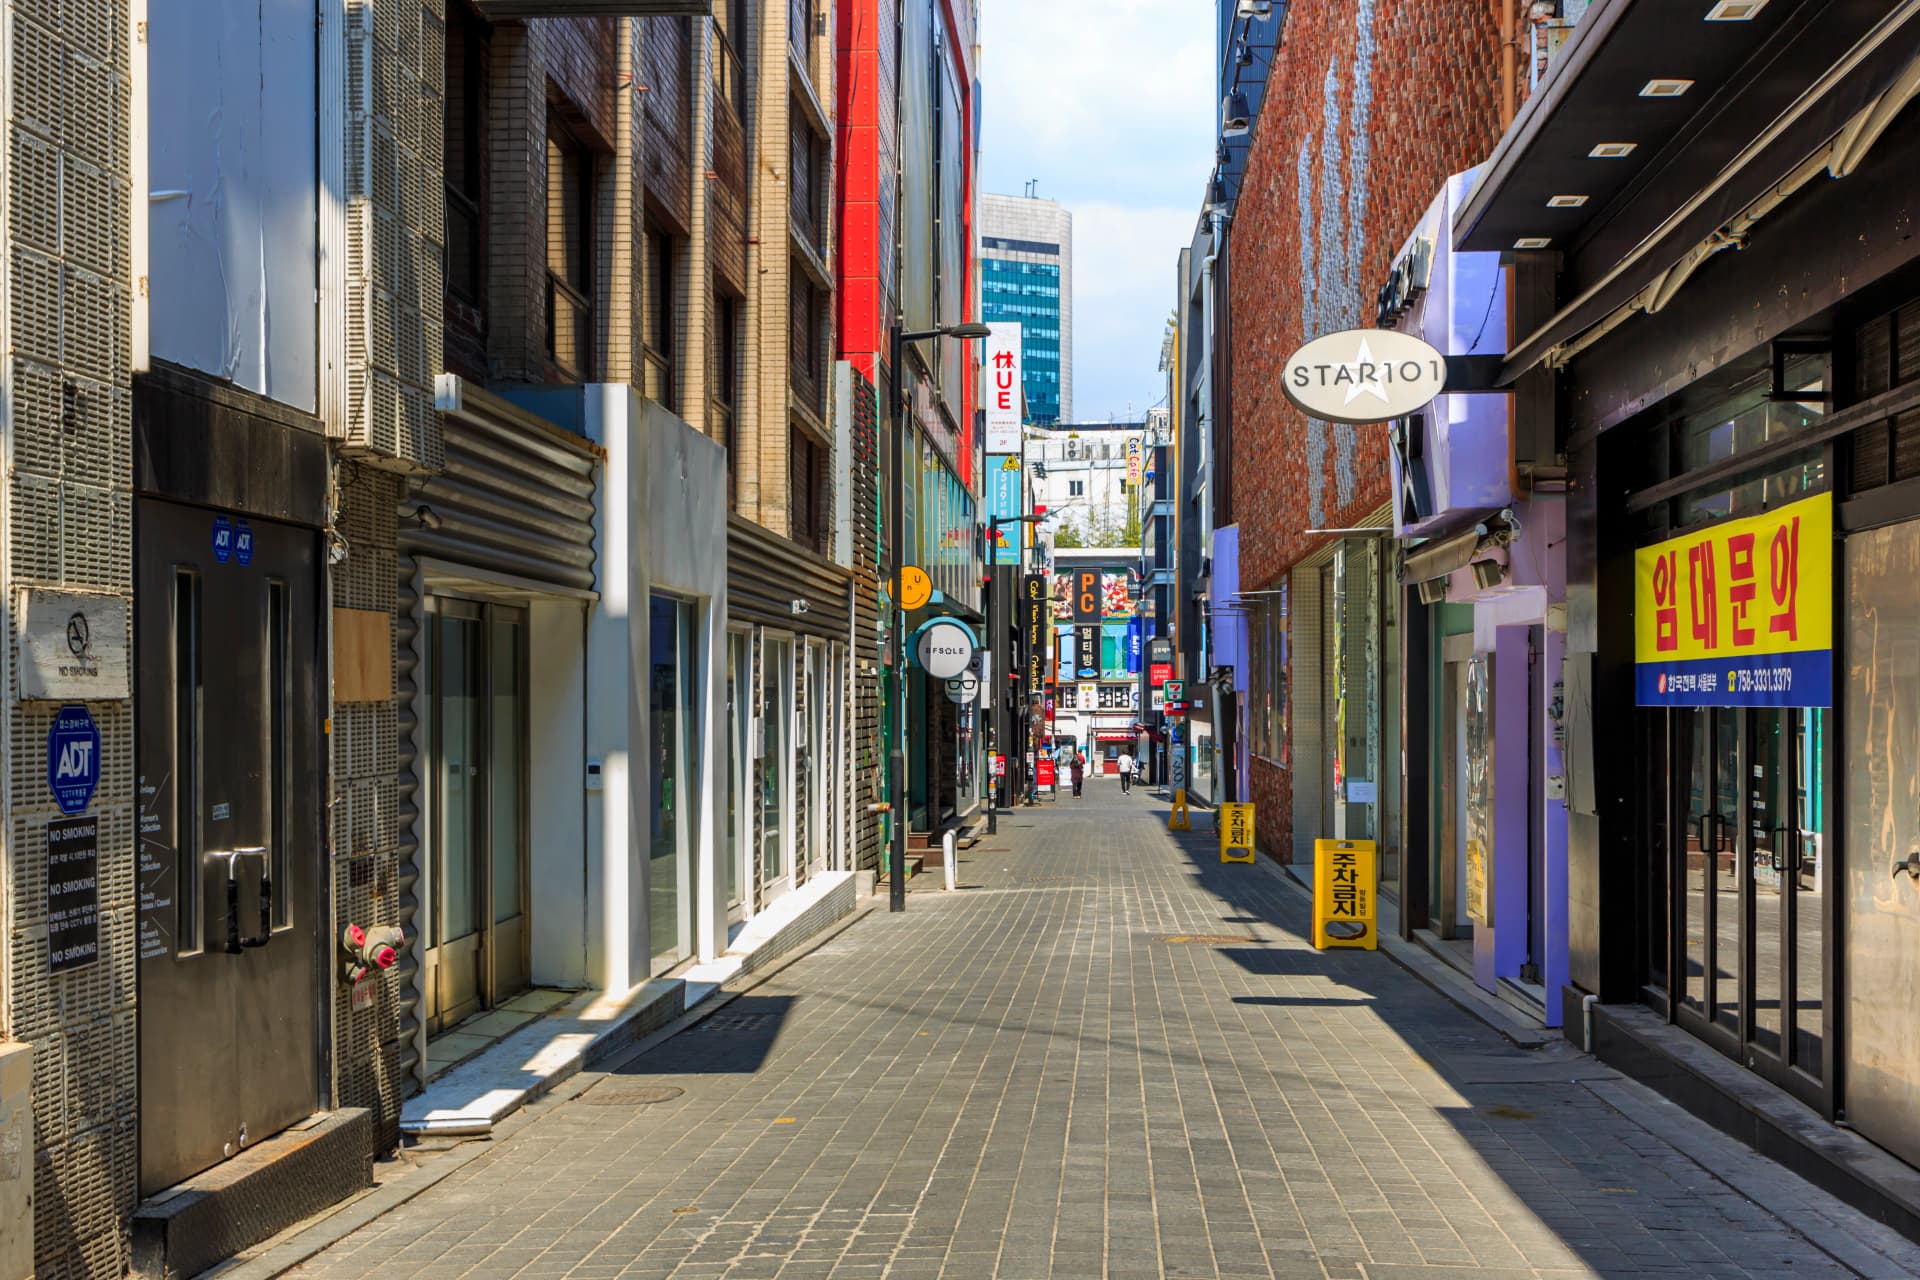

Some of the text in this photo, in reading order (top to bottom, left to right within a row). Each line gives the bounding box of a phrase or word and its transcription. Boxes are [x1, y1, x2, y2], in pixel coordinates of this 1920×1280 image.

[1293, 360, 1439, 388] STAR101
[1129, 438, 1139, 478] Cat Cafe
[216, 530, 230, 547] ADT
[237, 533, 251, 551] ADT
[1081, 573, 1095, 613] PC
[1652, 516, 1800, 651] 임대문의
[1082, 627, 1093, 667] 멀티방
[59, 666, 68, 677] NO
[1668, 674, 1696, 692] 한국전력
[1698, 673, 1717, 692] 서울본부
[57, 741, 93, 779] ADT
[50, 825, 96, 843] NO SMOKING
[50, 877, 96, 897] NO SMOKING
[1332, 853, 1359, 917] 주차금지
[52, 942, 97, 964] NO SMOKING
